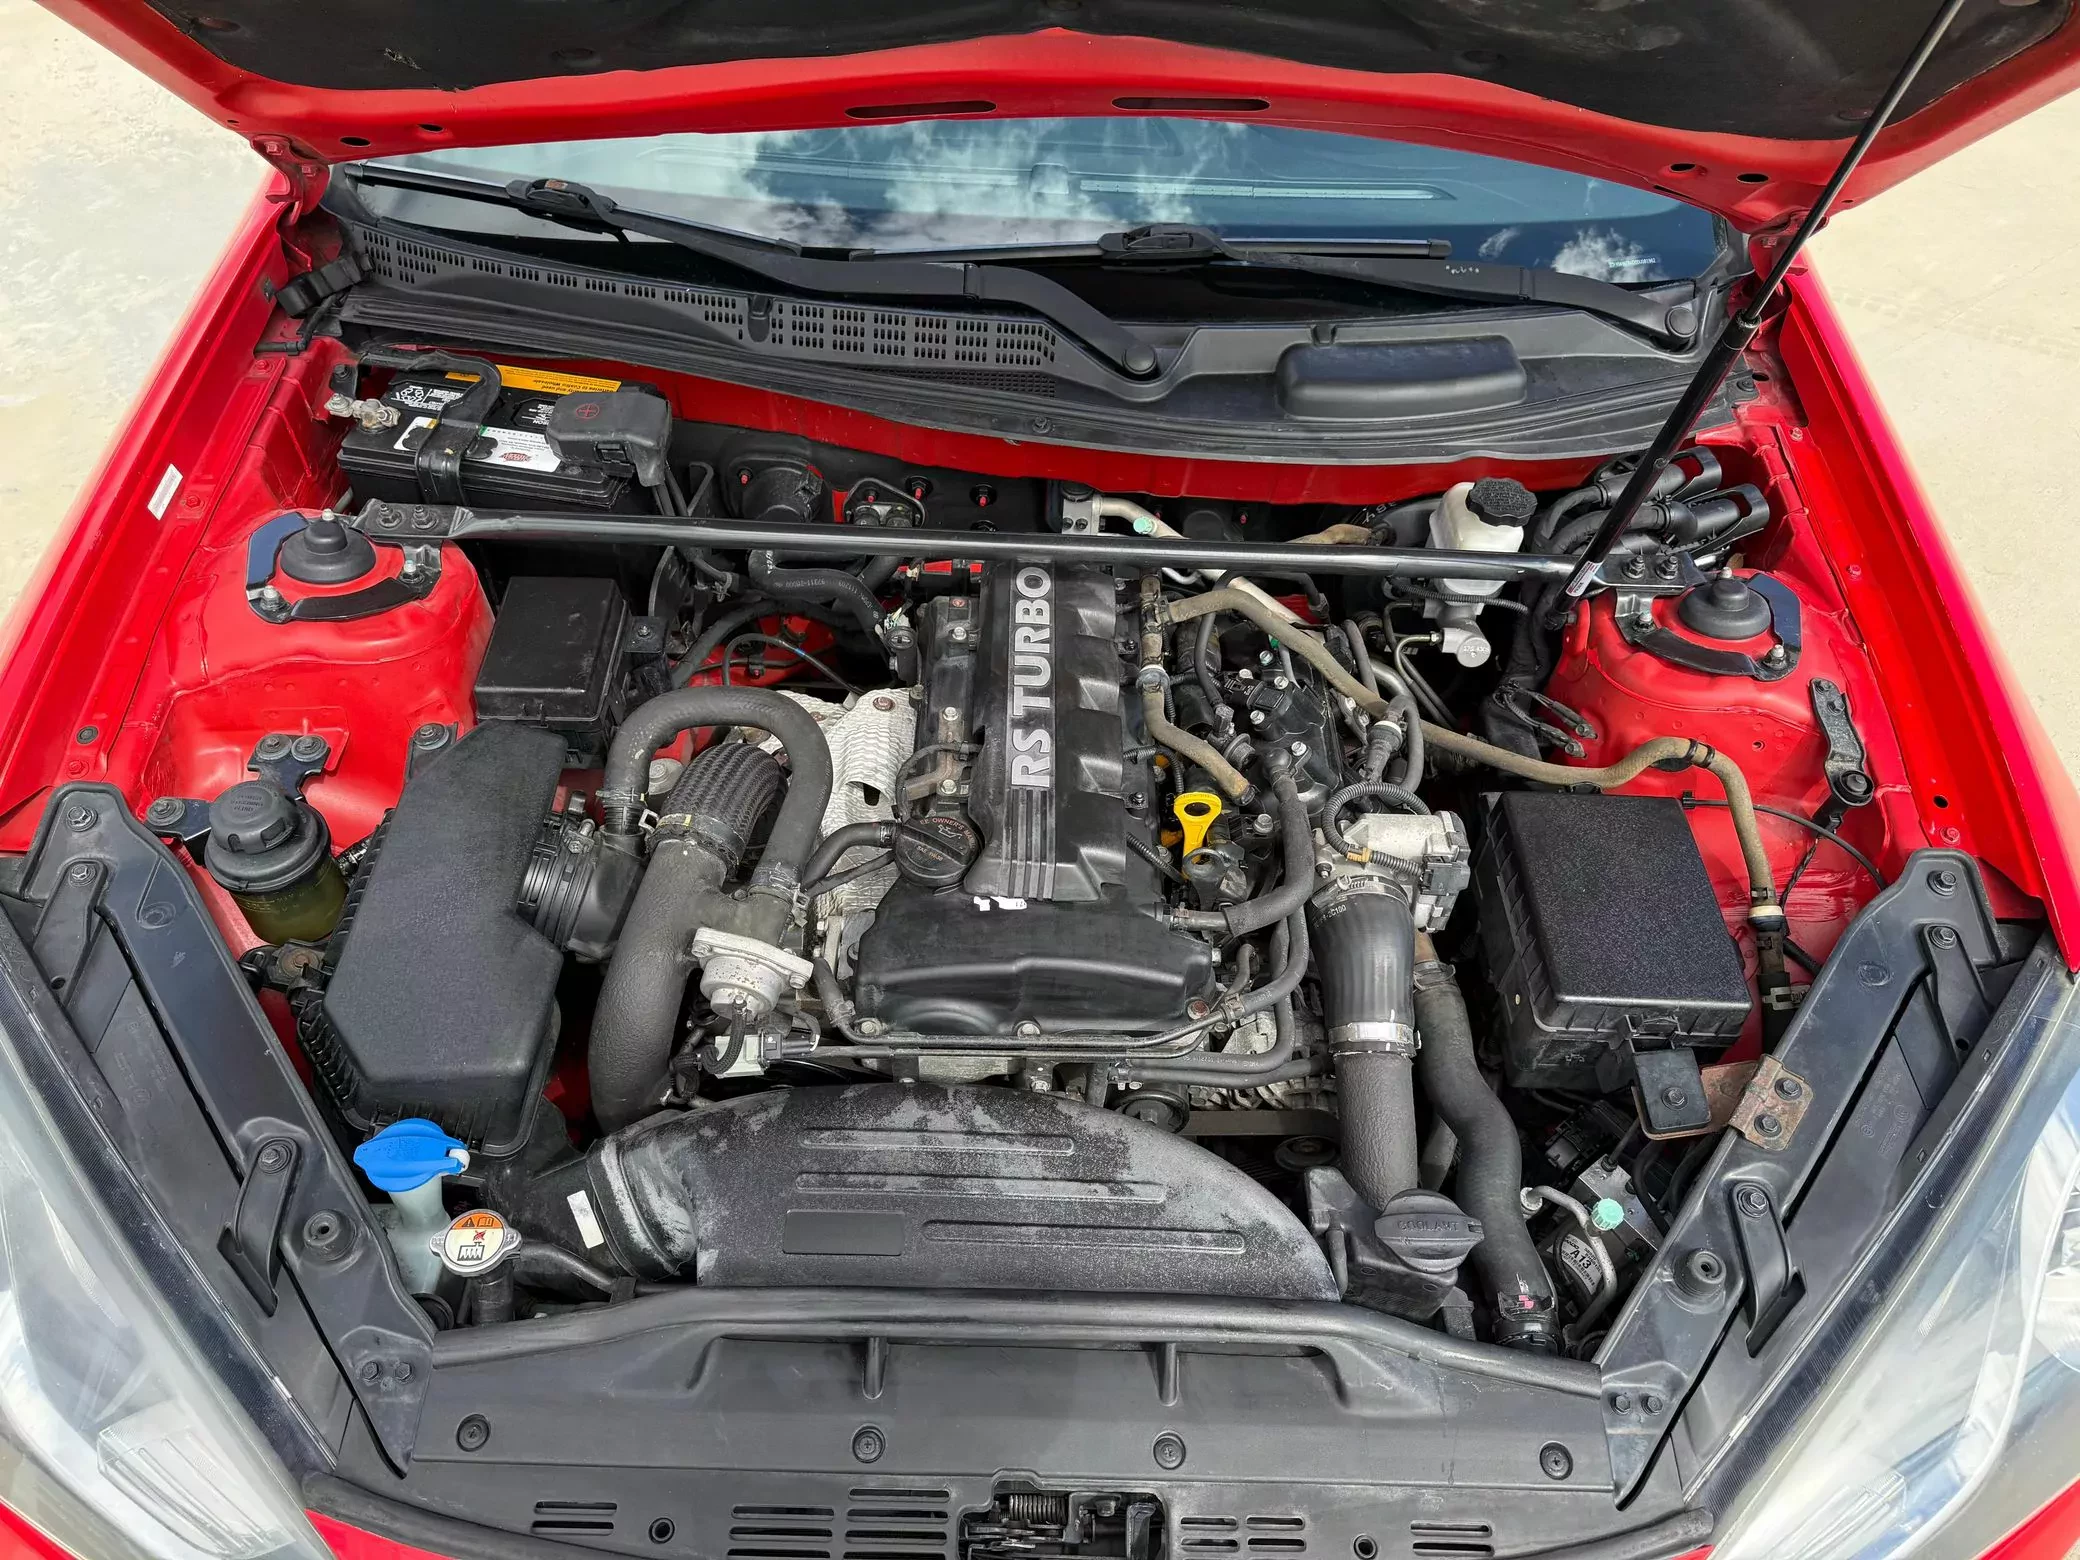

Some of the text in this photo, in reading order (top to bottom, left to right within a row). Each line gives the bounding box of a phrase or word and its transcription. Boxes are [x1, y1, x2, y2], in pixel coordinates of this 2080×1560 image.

[1011, 566, 1052, 788] RS TURBO
[932, 817, 965, 831] OWNER'S
[1398, 1219, 1460, 1232] COOLANT
[1570, 1249, 1592, 1269] A13
